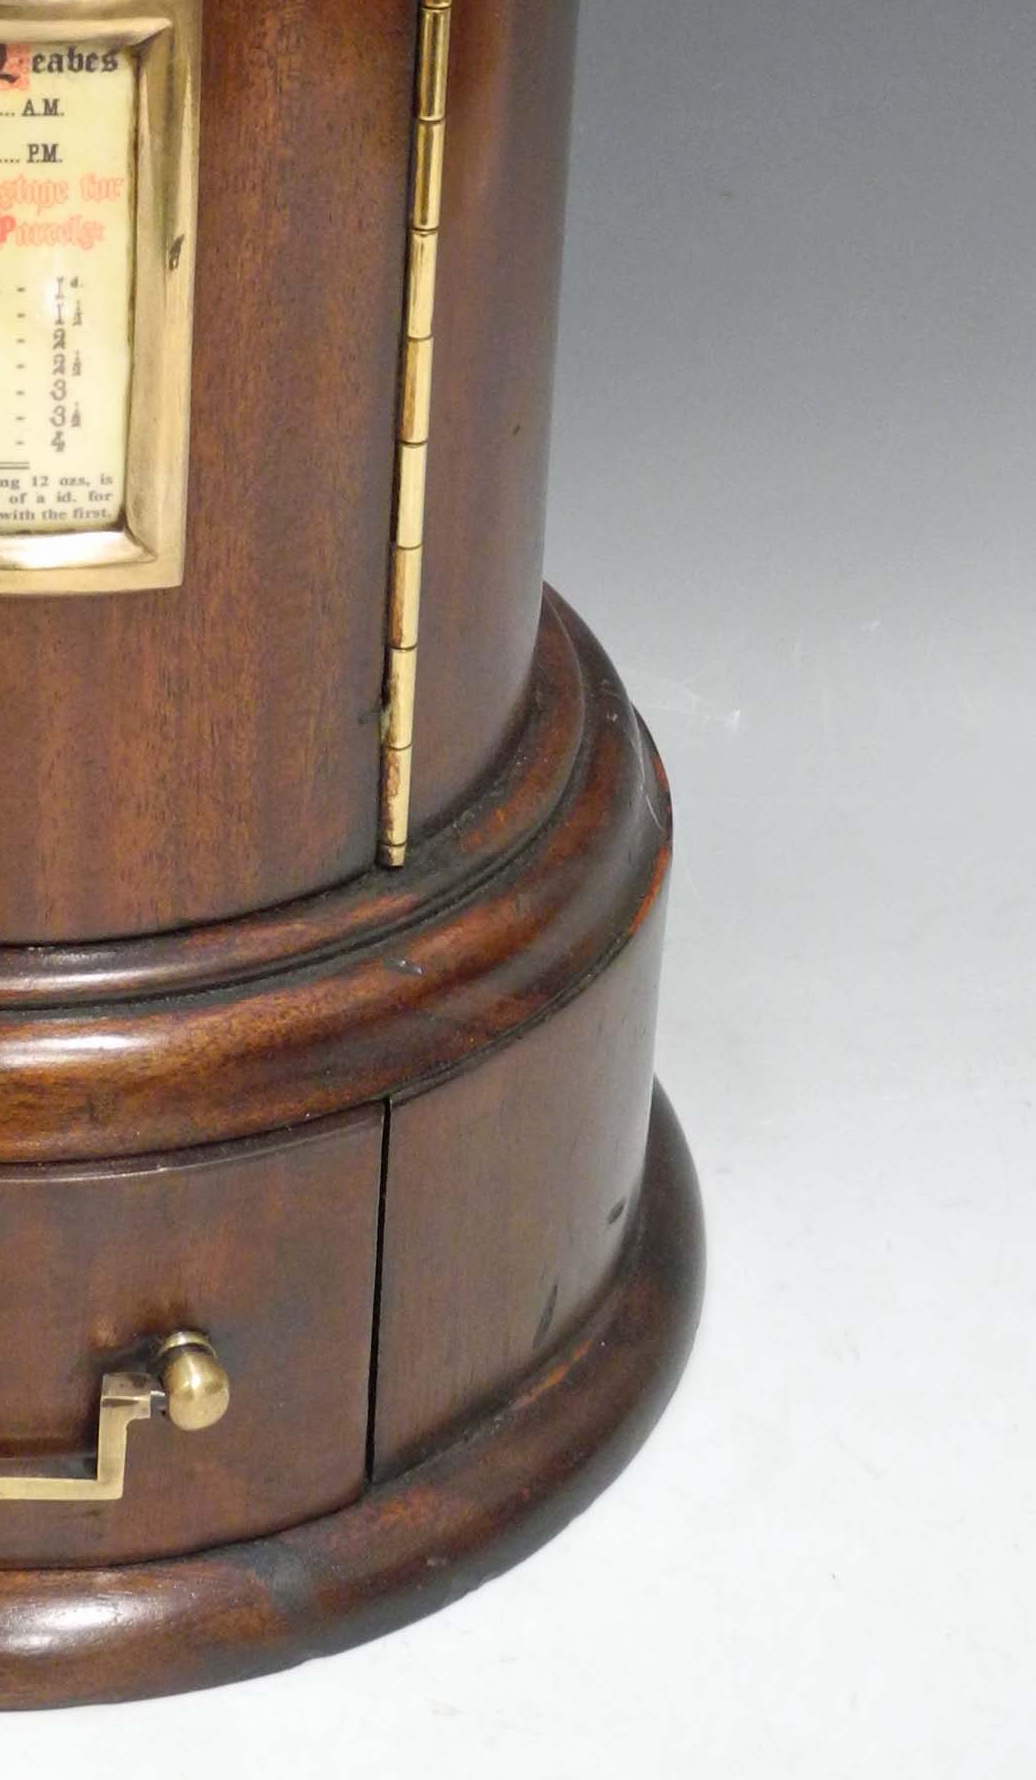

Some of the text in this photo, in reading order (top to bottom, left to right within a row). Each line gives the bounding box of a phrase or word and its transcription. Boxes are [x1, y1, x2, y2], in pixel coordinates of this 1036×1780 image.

[53, 327, 66, 351] 2
[50, 379, 66, 402] 3
[52, 431, 66, 453] 4
[31, 475, 49, 487] 12
[100, 473, 114, 485] is
[10, 490, 27, 504] of
[36, 495, 45, 504] a
[88, 489, 113, 502] for
[0, 508, 36, 521] with
[42, 508, 67, 521] the
